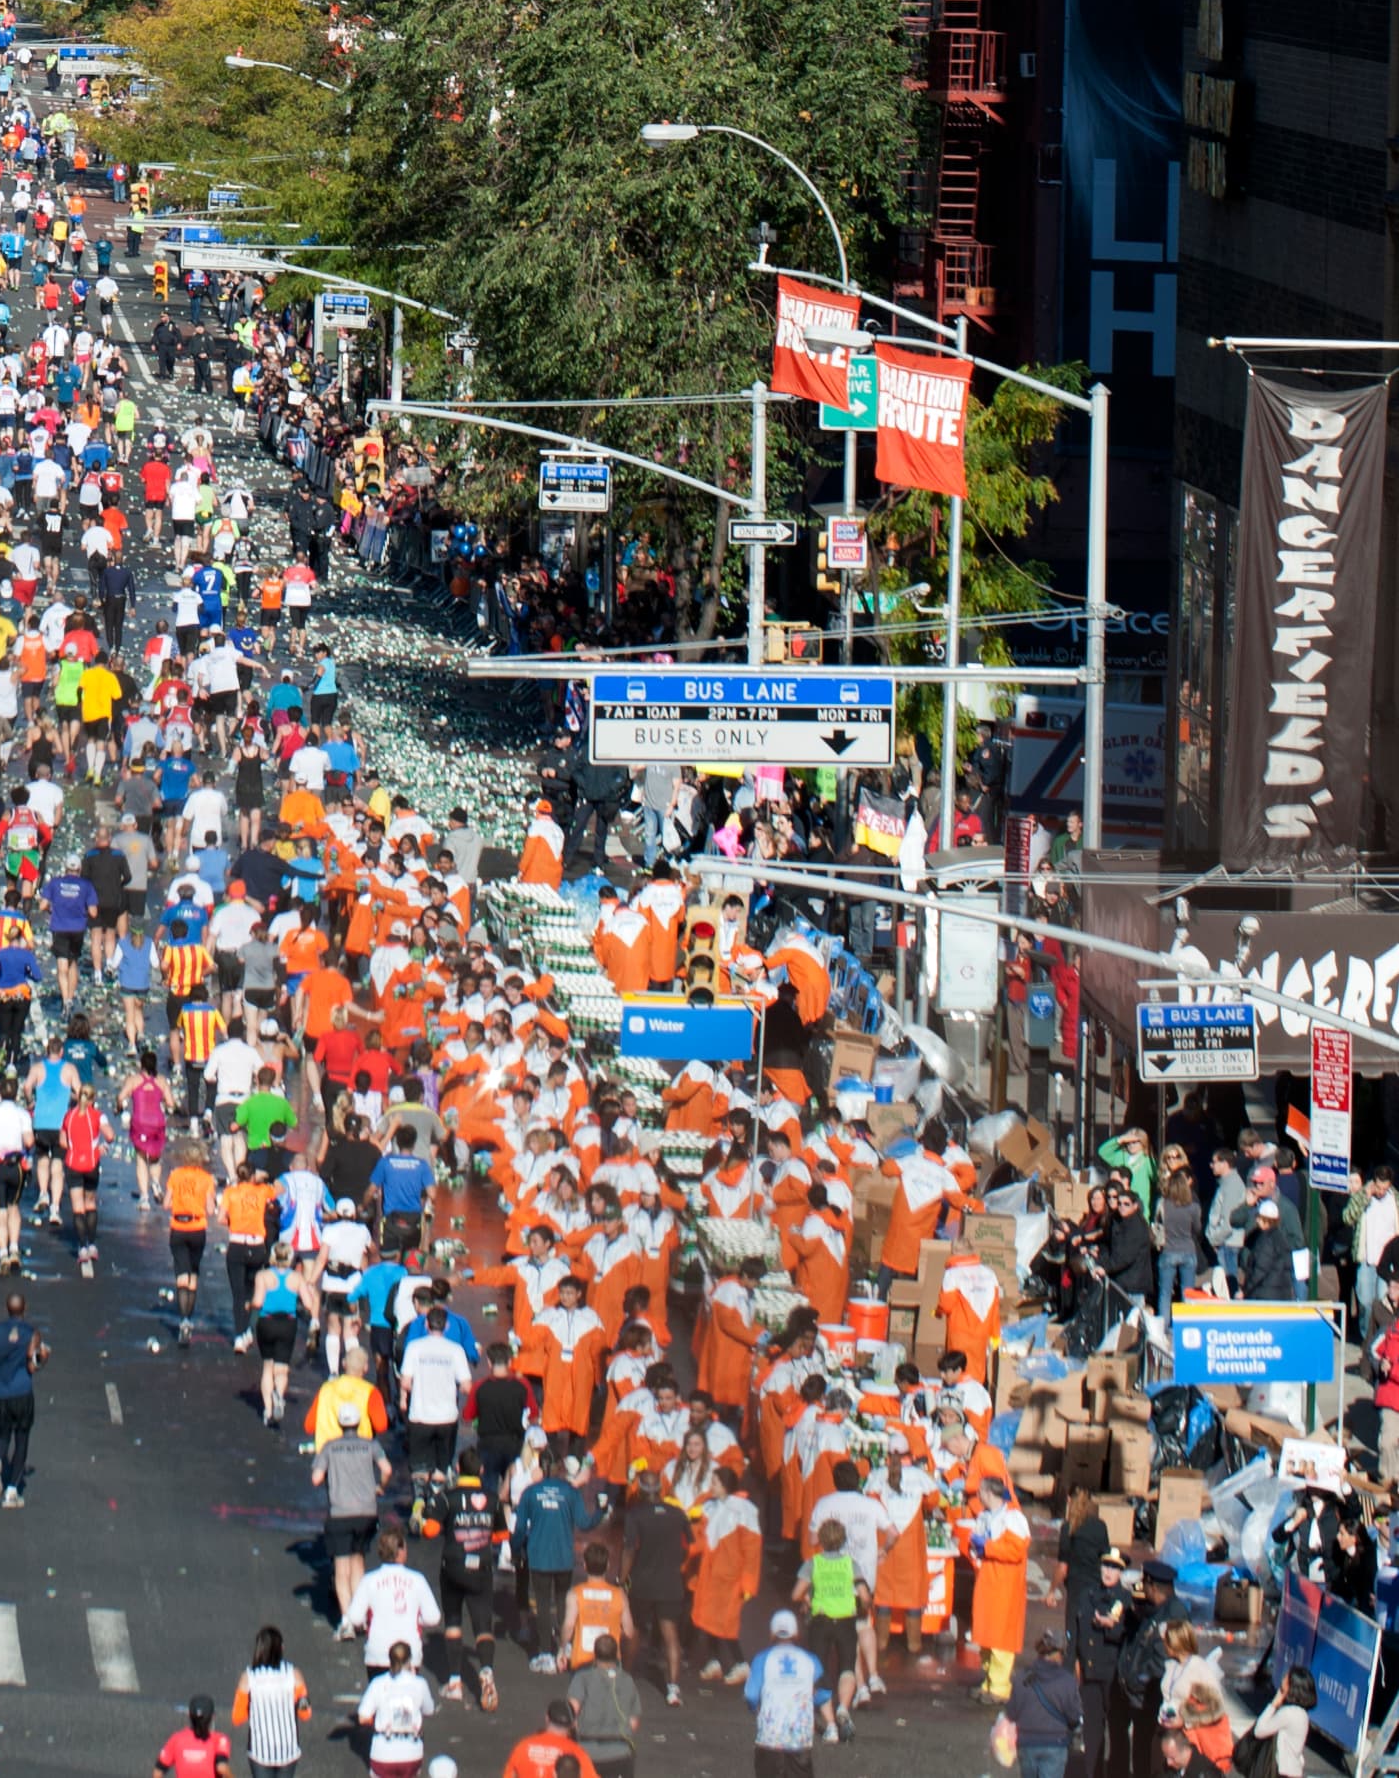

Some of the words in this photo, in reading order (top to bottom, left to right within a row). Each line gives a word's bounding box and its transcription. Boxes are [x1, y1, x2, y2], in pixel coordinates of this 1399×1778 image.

[878, 362, 965, 411] MARATHON
[877, 391, 961, 447] ROUTE
[739, 527, 757, 536] ONE
[766, 527, 785, 537] WAY
[685, 681, 723, 700] BUS
[743, 683, 797, 702] LANE
[635, 728, 702, 745] BUSES
[715, 728, 768, 746] ONLY
[860, 807, 905, 837] STEFAN
[1171, 1010, 1200, 1022] BUS
[1205, 1009, 1245, 1022] LANE
[649, 1018, 685, 1033] Water
[1180, 1053, 1216, 1065] BUSES
[1222, 1053, 1249, 1065] ONLY
[1206, 1329, 1273, 1345] Gatorade
[1206, 1344, 1282, 1359] Endurance
[1207, 1359, 1267, 1374] Formula
[1318, 1671, 1347, 1705] UNITED
